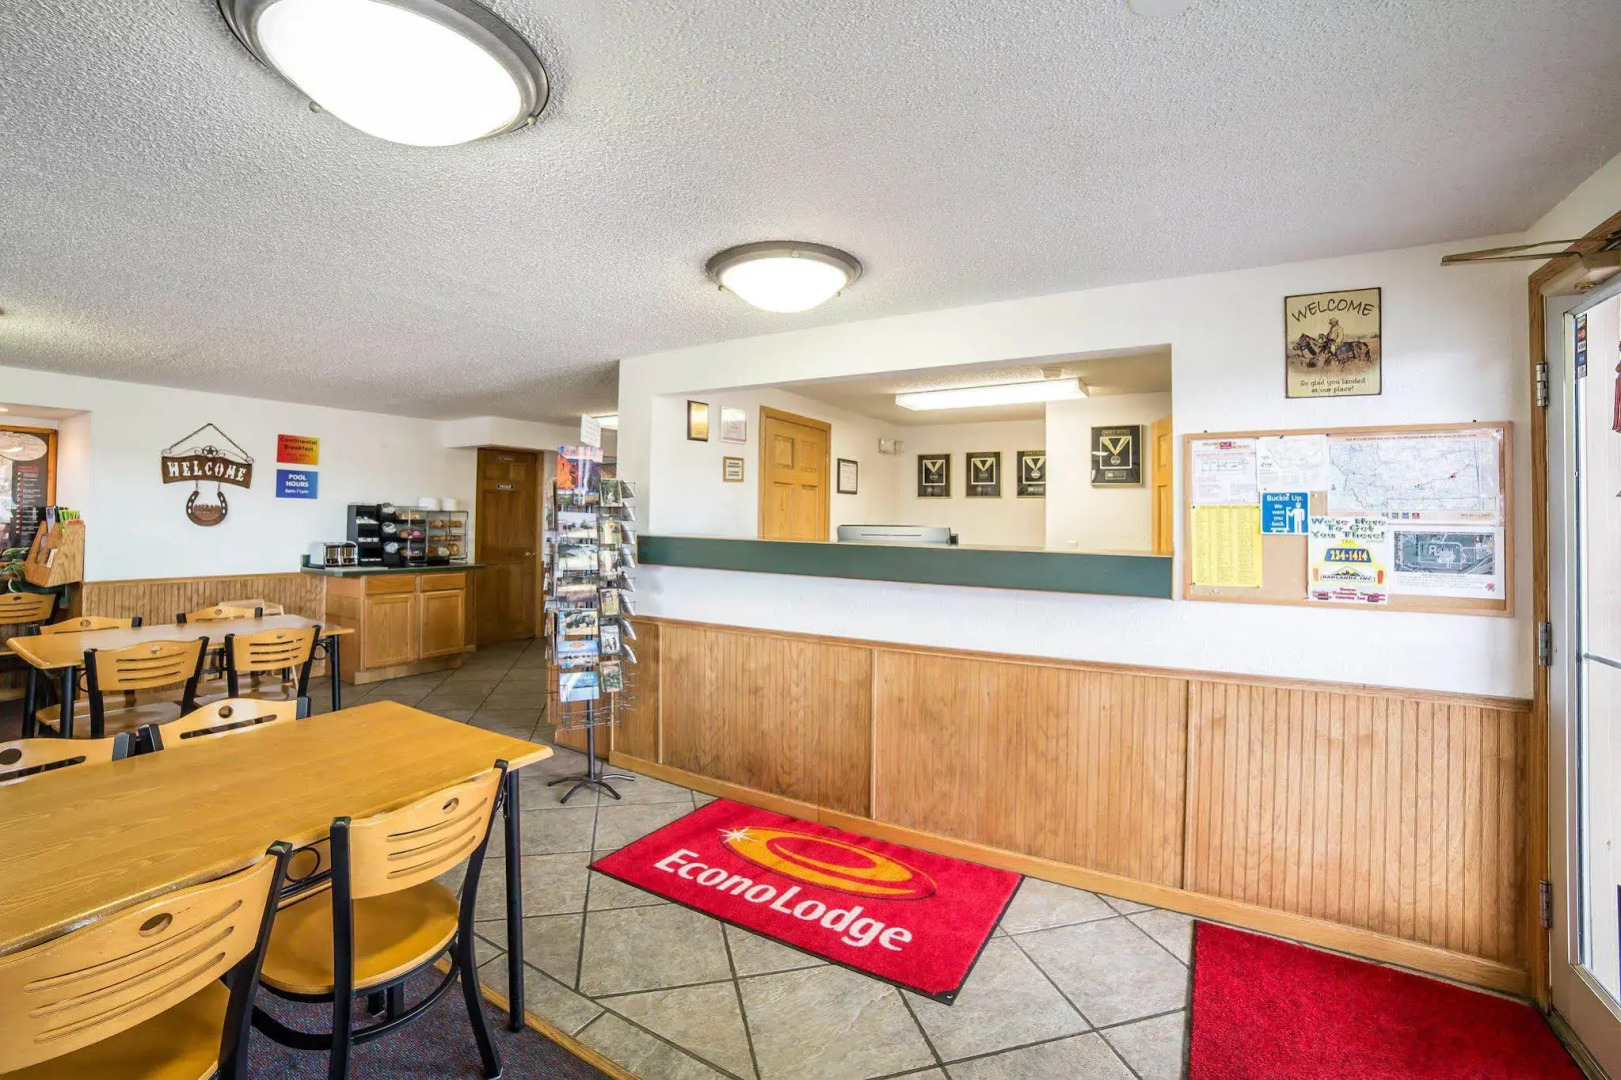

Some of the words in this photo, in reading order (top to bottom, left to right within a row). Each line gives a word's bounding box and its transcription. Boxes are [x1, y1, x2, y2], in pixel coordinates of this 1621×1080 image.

[1291, 298, 1374, 322] WELCOME
[1310, 379, 1325, 388] glad
[1327, 379, 1340, 387] you
[1342, 377, 1366, 385] landed
[1333, 386, 1354, 394] place!
[280, 436, 318, 446] Continental
[284, 444, 314, 452] Breakfast
[167, 461, 247, 482] WELCOME
[288, 473, 307, 481] POOL
[1291, 494, 1304, 503] Up.
[1311, 517, 1350, 526] We're
[1354, 517, 1387, 526] Here
[1328, 524, 1343, 532] To
[1349, 524, 1374, 532] Get
[1311, 530, 1336, 539] You
[1342, 530, 1385, 539] There!
[653, 848, 913, 951] EconoLodge
